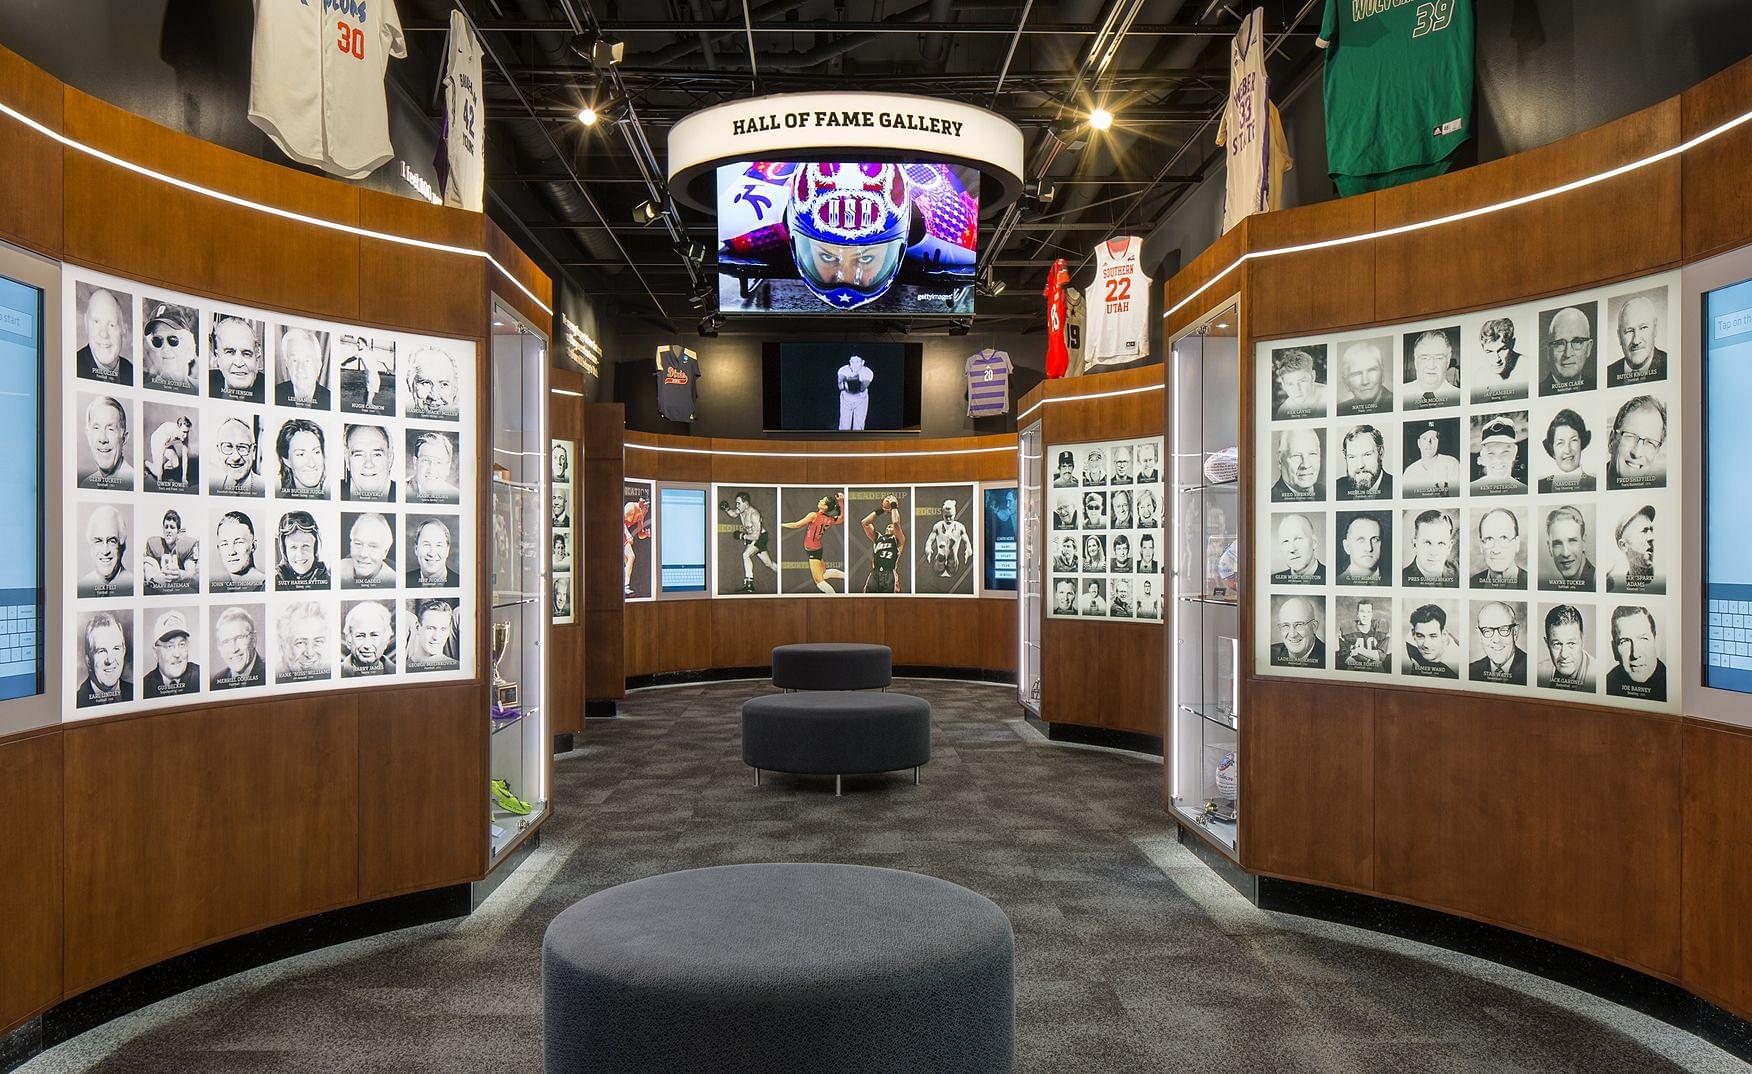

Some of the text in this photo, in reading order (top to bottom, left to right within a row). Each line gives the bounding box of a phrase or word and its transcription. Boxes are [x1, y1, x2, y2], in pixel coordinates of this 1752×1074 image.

[337, 21, 365, 60] 30
[463, 98, 474, 139] 42
[1239, 95, 1251, 129] 33
[733, 112, 963, 137] HALL OF FAME GALLERY
[828, 198, 872, 229] USA
[1103, 264, 1134, 279] SOUTHERN
[1105, 277, 1131, 302] 22
[1106, 302, 1129, 314] UTAH
[1717, 314, 1752, 331] Tap on th
[984, 369, 993, 381] 20
[1634, 369, 1657, 378] KNOWLES
[235, 389, 253, 397] JENSON
[880, 550, 893, 559] 32
[1631, 685, 1651, 693] BARNEY
